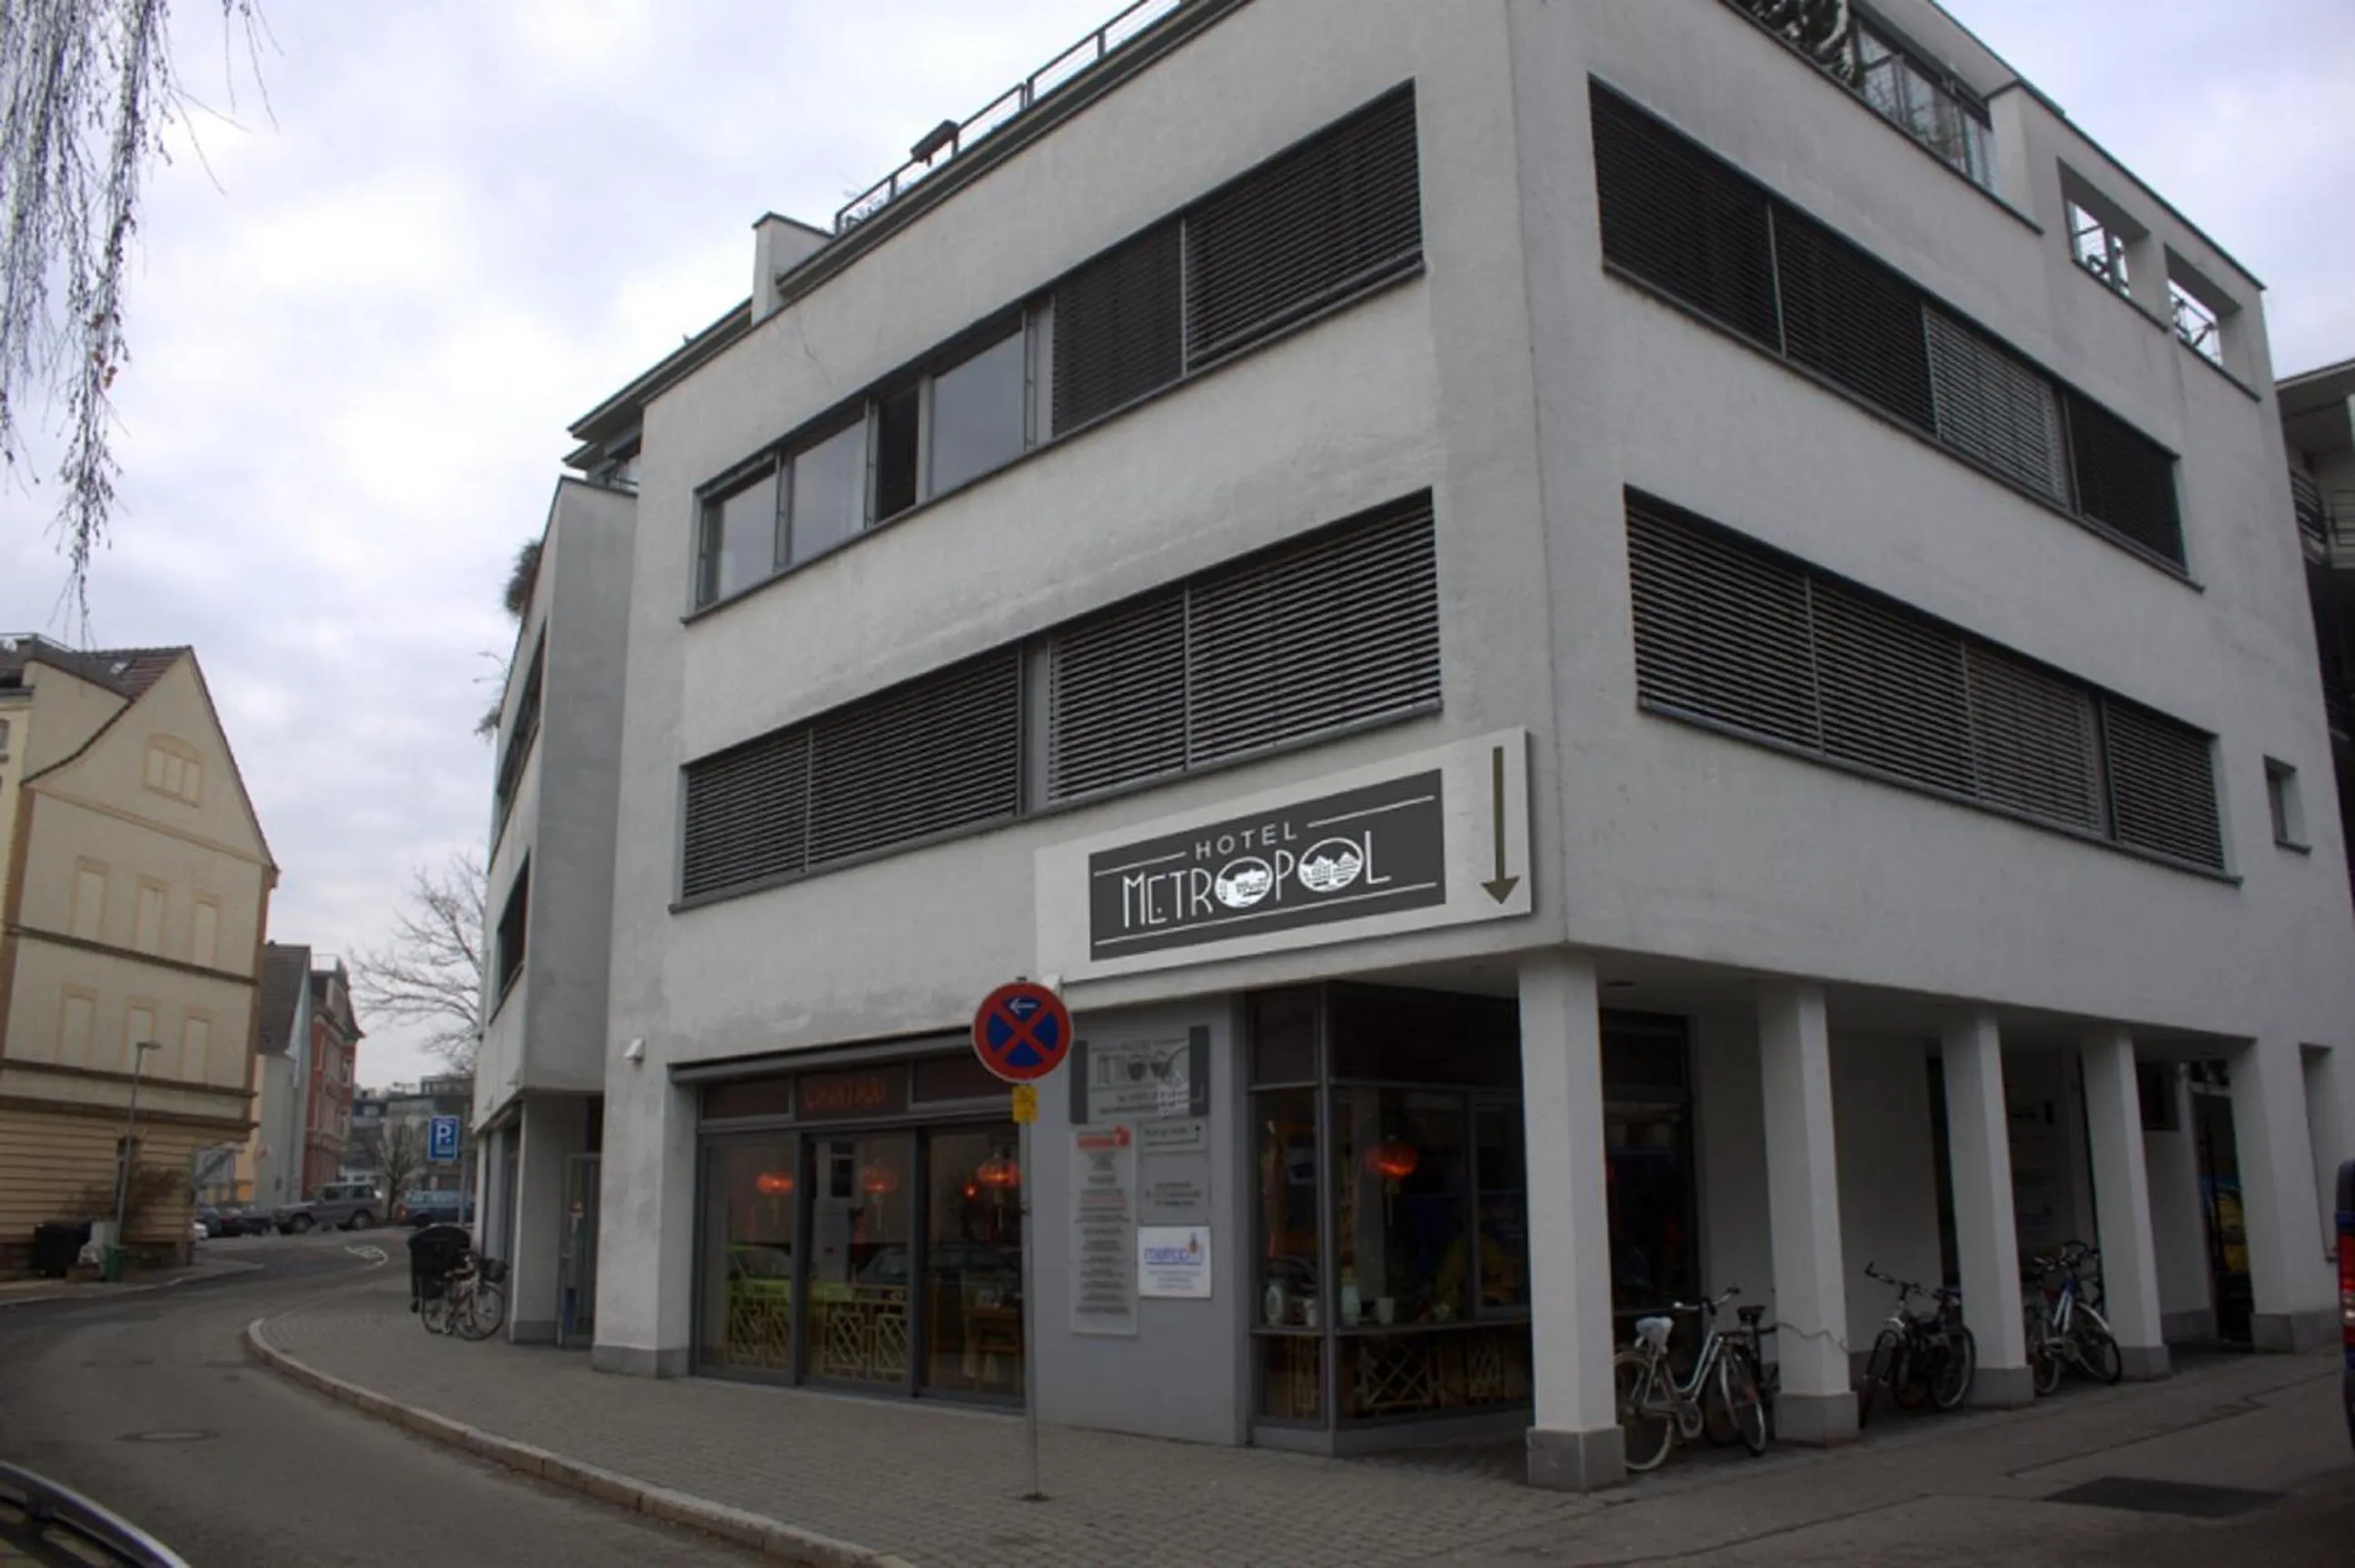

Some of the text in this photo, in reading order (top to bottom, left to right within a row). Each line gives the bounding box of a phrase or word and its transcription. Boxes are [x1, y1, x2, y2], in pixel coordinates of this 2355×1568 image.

[1195, 821, 1298, 859] HOTEL
[1122, 829, 1391, 928] METROPOL
[436, 1125, 451, 1144] P
